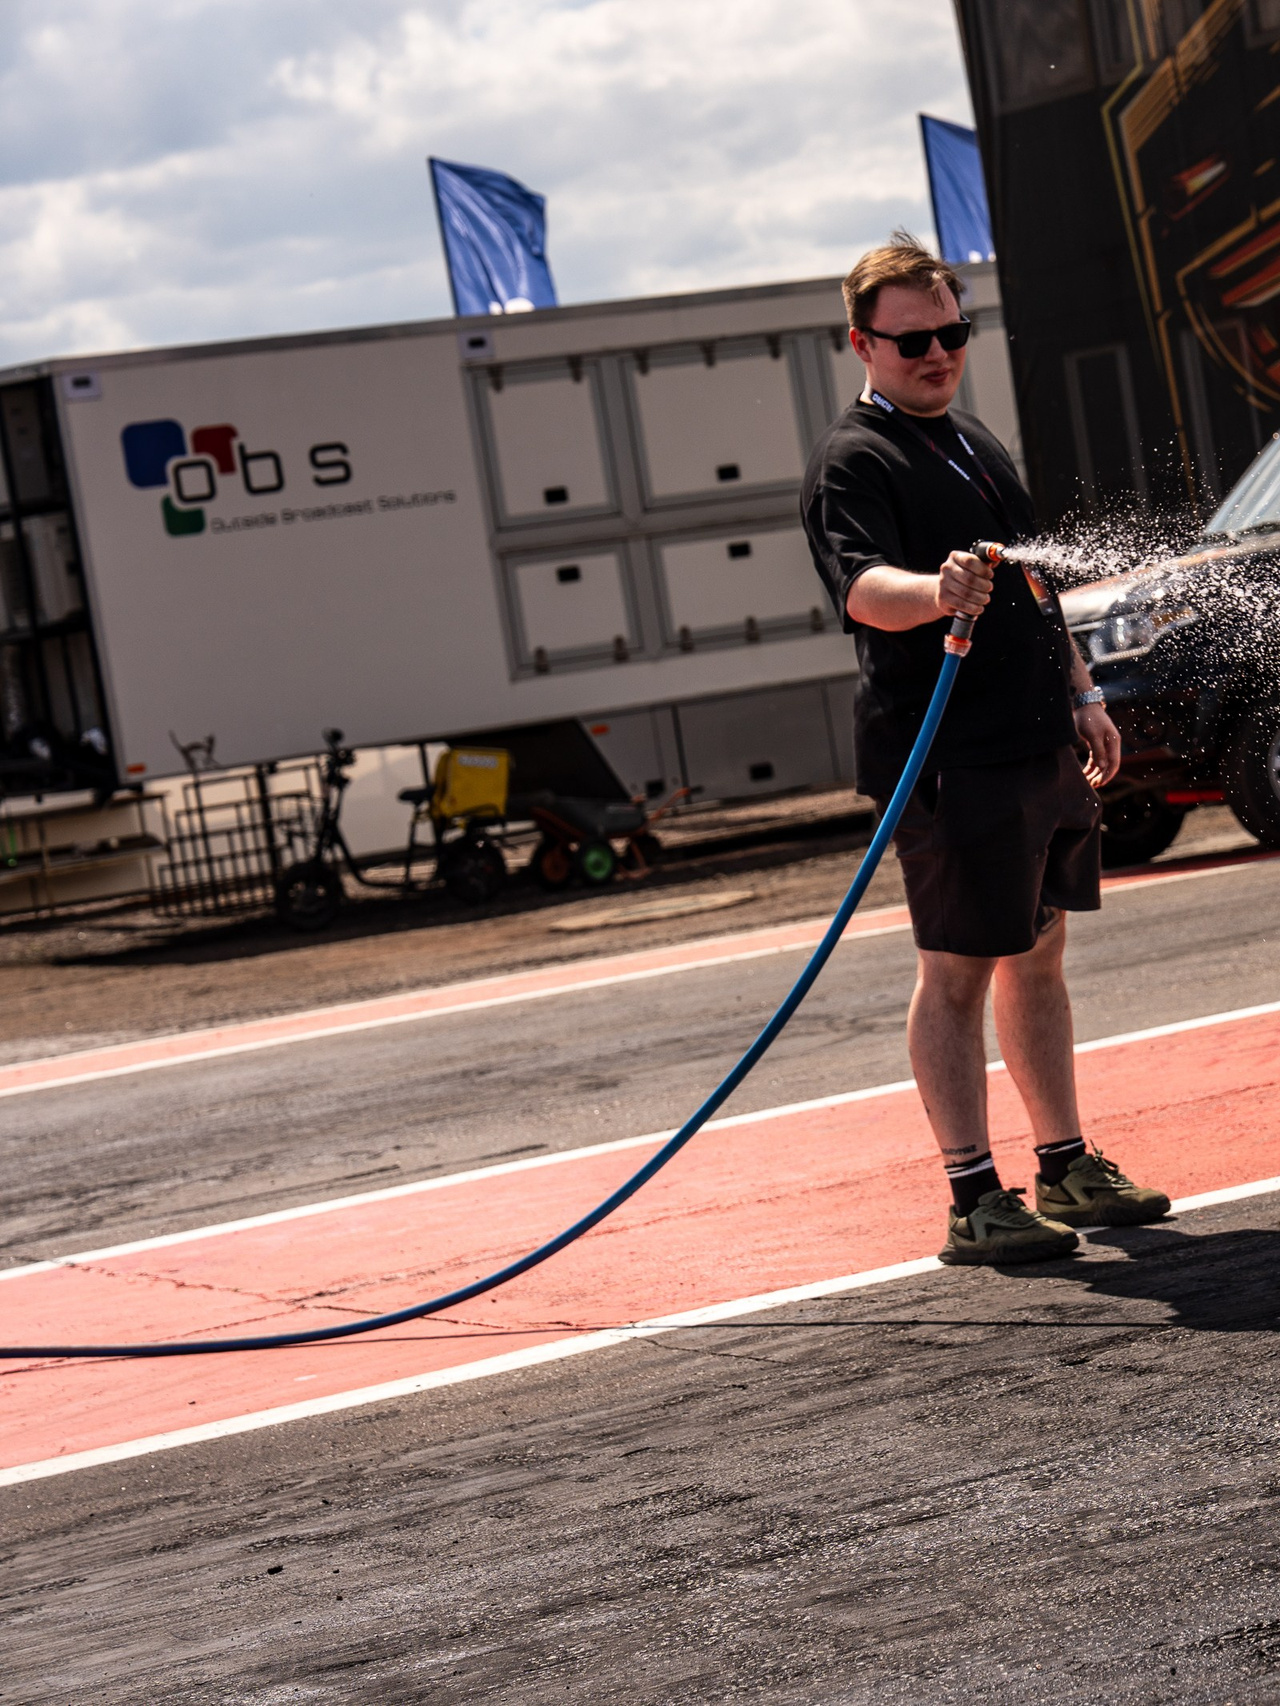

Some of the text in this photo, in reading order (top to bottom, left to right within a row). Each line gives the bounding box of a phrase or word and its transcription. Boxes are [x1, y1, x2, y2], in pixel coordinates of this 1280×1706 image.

[172, 441, 352, 504] obs
[211, 489, 458, 534] Outside Broadcast Solutions
